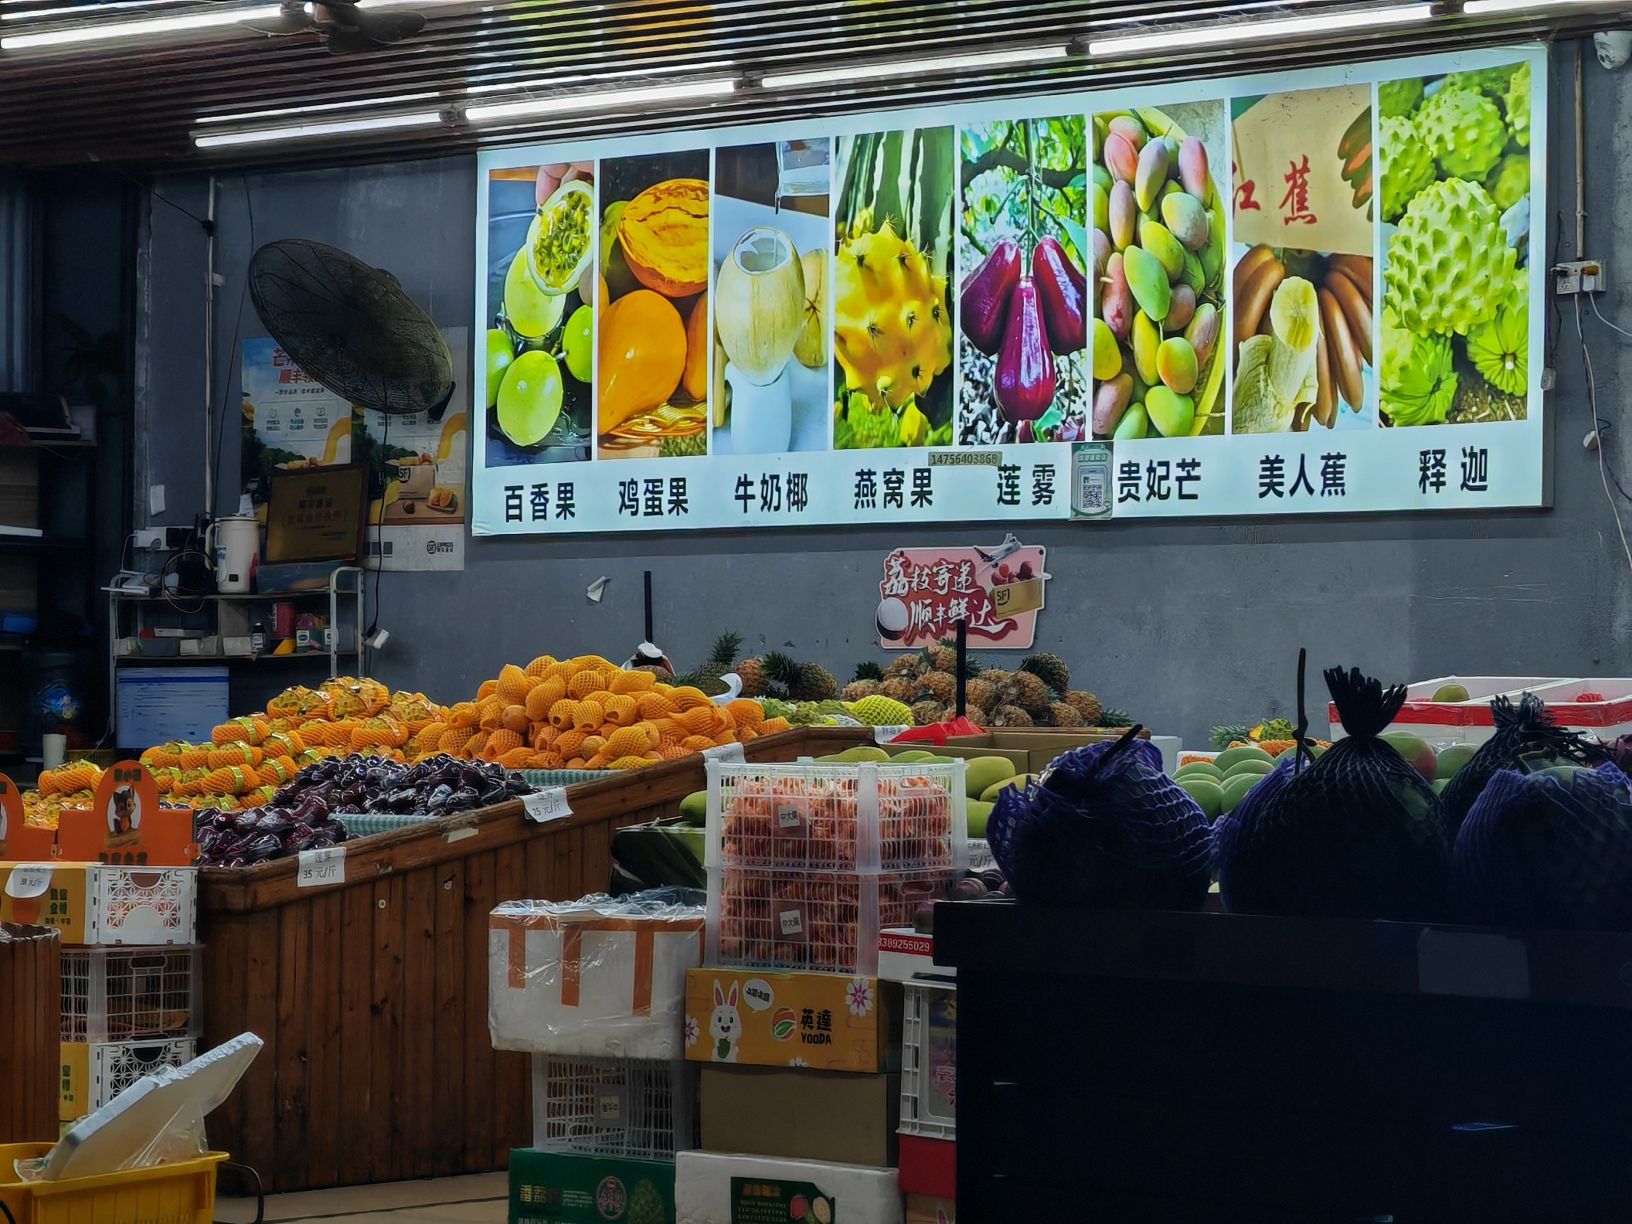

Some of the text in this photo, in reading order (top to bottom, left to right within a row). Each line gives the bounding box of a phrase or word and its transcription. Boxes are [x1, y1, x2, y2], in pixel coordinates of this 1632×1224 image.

[854, 468, 933, 509] 燕窝果
[996, 464, 1056, 506] 莲雾
[1117, 458, 1202, 503] 贵妃芒
[1258, 453, 1347, 498] 美人蕉
[1419, 446, 1488, 494] 释迦
[504, 482, 576, 522] 百香果
[618, 477, 688, 516] 鸡蛋果
[734, 472, 808, 513] 牛奶椰
[885, 556, 982, 596] 荔枝寄递
[906, 597, 1009, 637] 顺丰鲜达
[801, 1008, 831, 1031] 英達
[801, 1032, 832, 1045] YOODA
